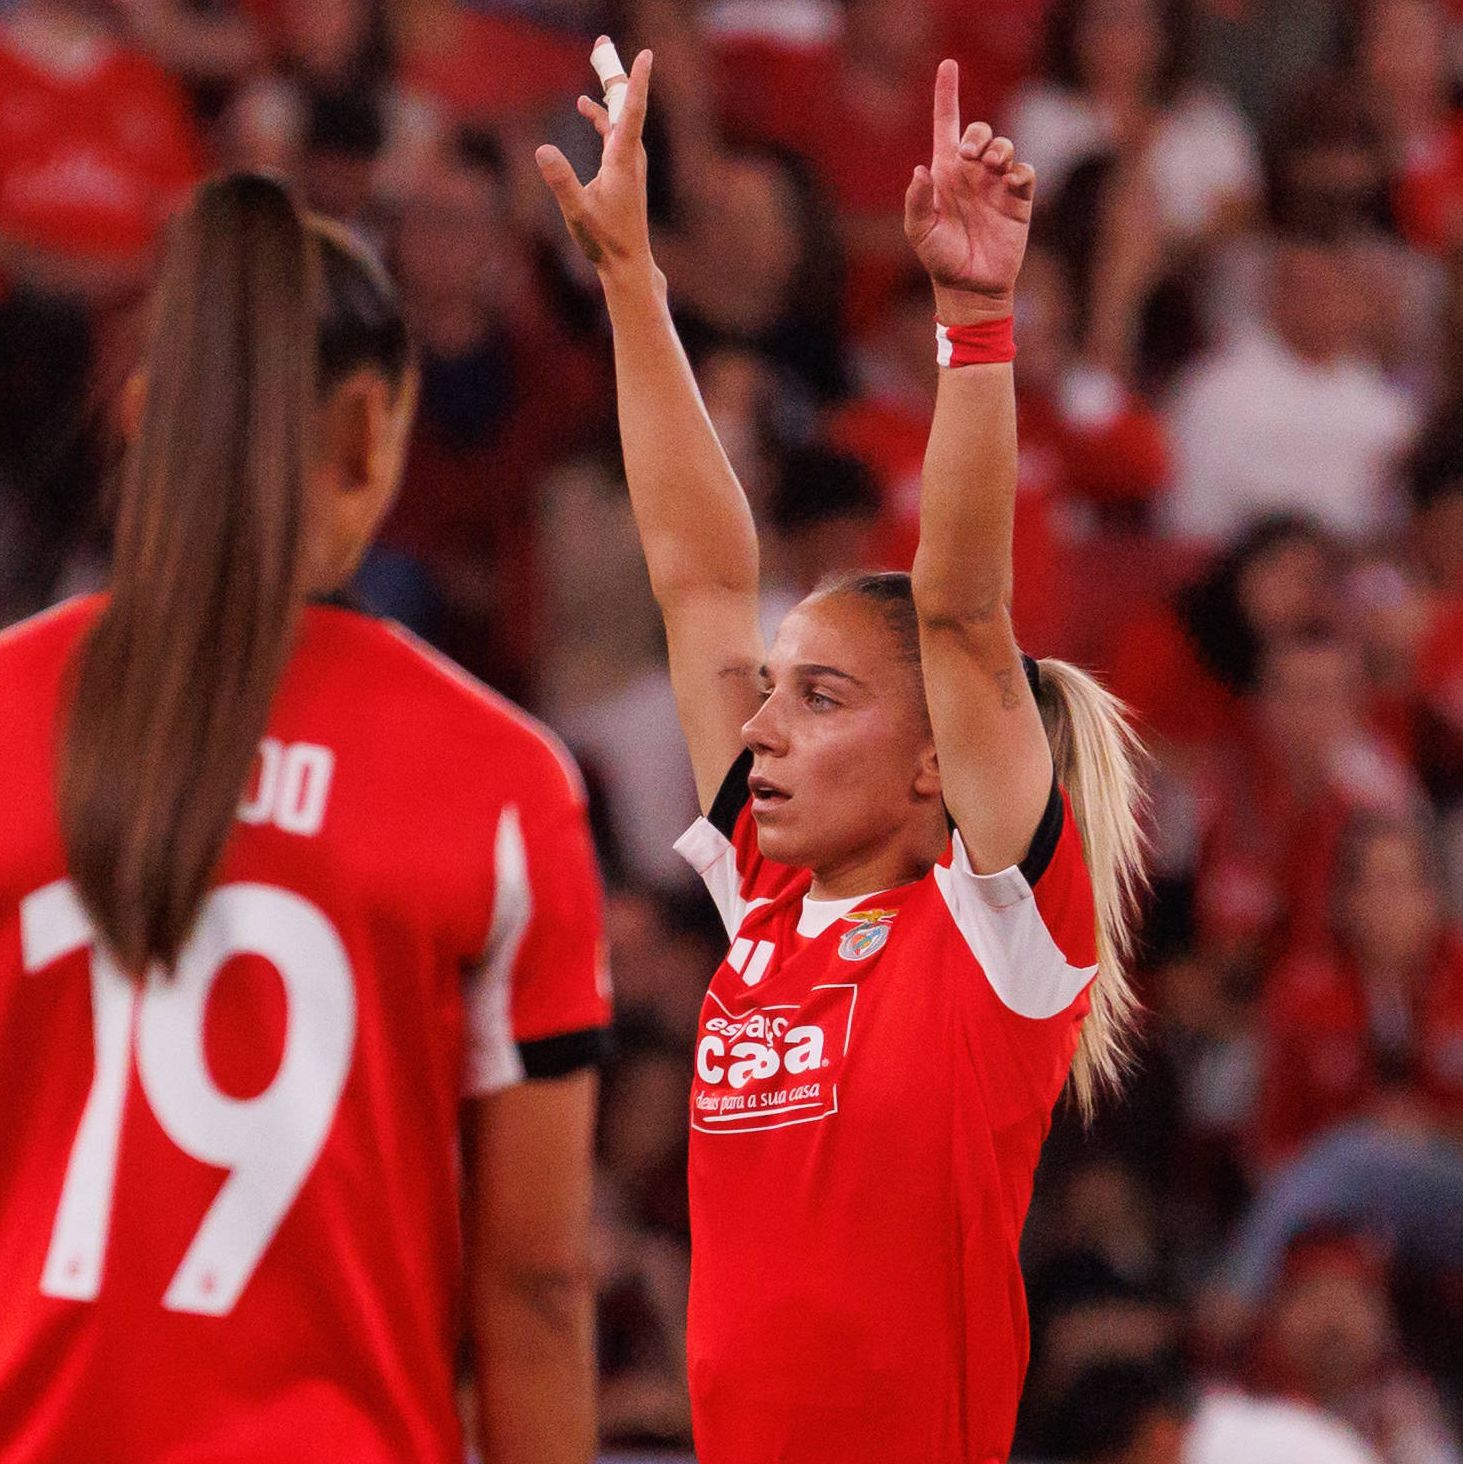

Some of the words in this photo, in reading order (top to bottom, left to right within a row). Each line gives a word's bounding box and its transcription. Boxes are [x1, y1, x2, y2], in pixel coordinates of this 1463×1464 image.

[19, 879, 358, 1318] 19
[747, 1094, 757, 1108] a
[760, 1090, 787, 1106] sua
[788, 1083, 821, 1102] casa
